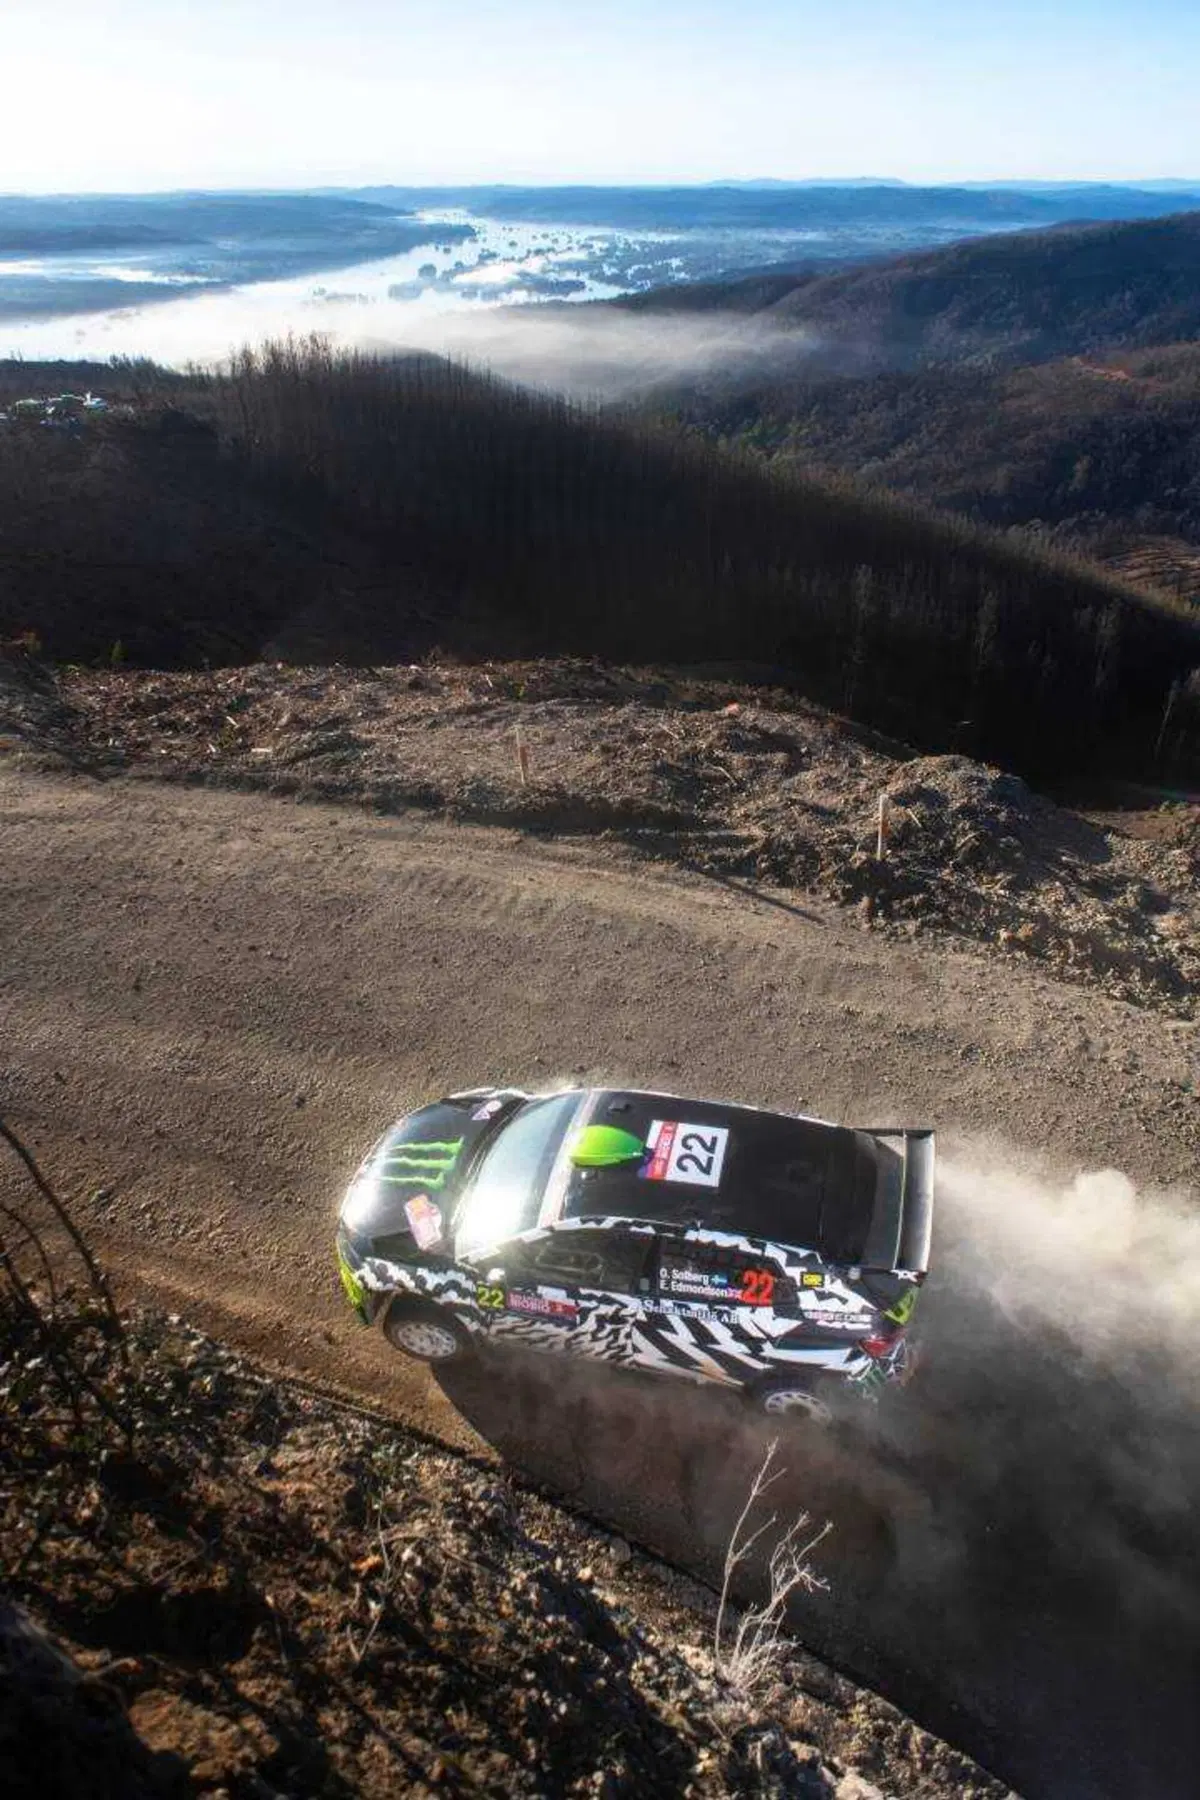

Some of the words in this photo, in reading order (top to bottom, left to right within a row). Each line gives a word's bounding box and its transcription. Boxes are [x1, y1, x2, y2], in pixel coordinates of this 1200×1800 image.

[676, 1133, 718, 1175] 22
[672, 1269, 709, 1285] Solberg
[742, 1269, 774, 1306] 22
[478, 1287, 505, 1309] 22
[671, 1281, 728, 1298] Edmondson
